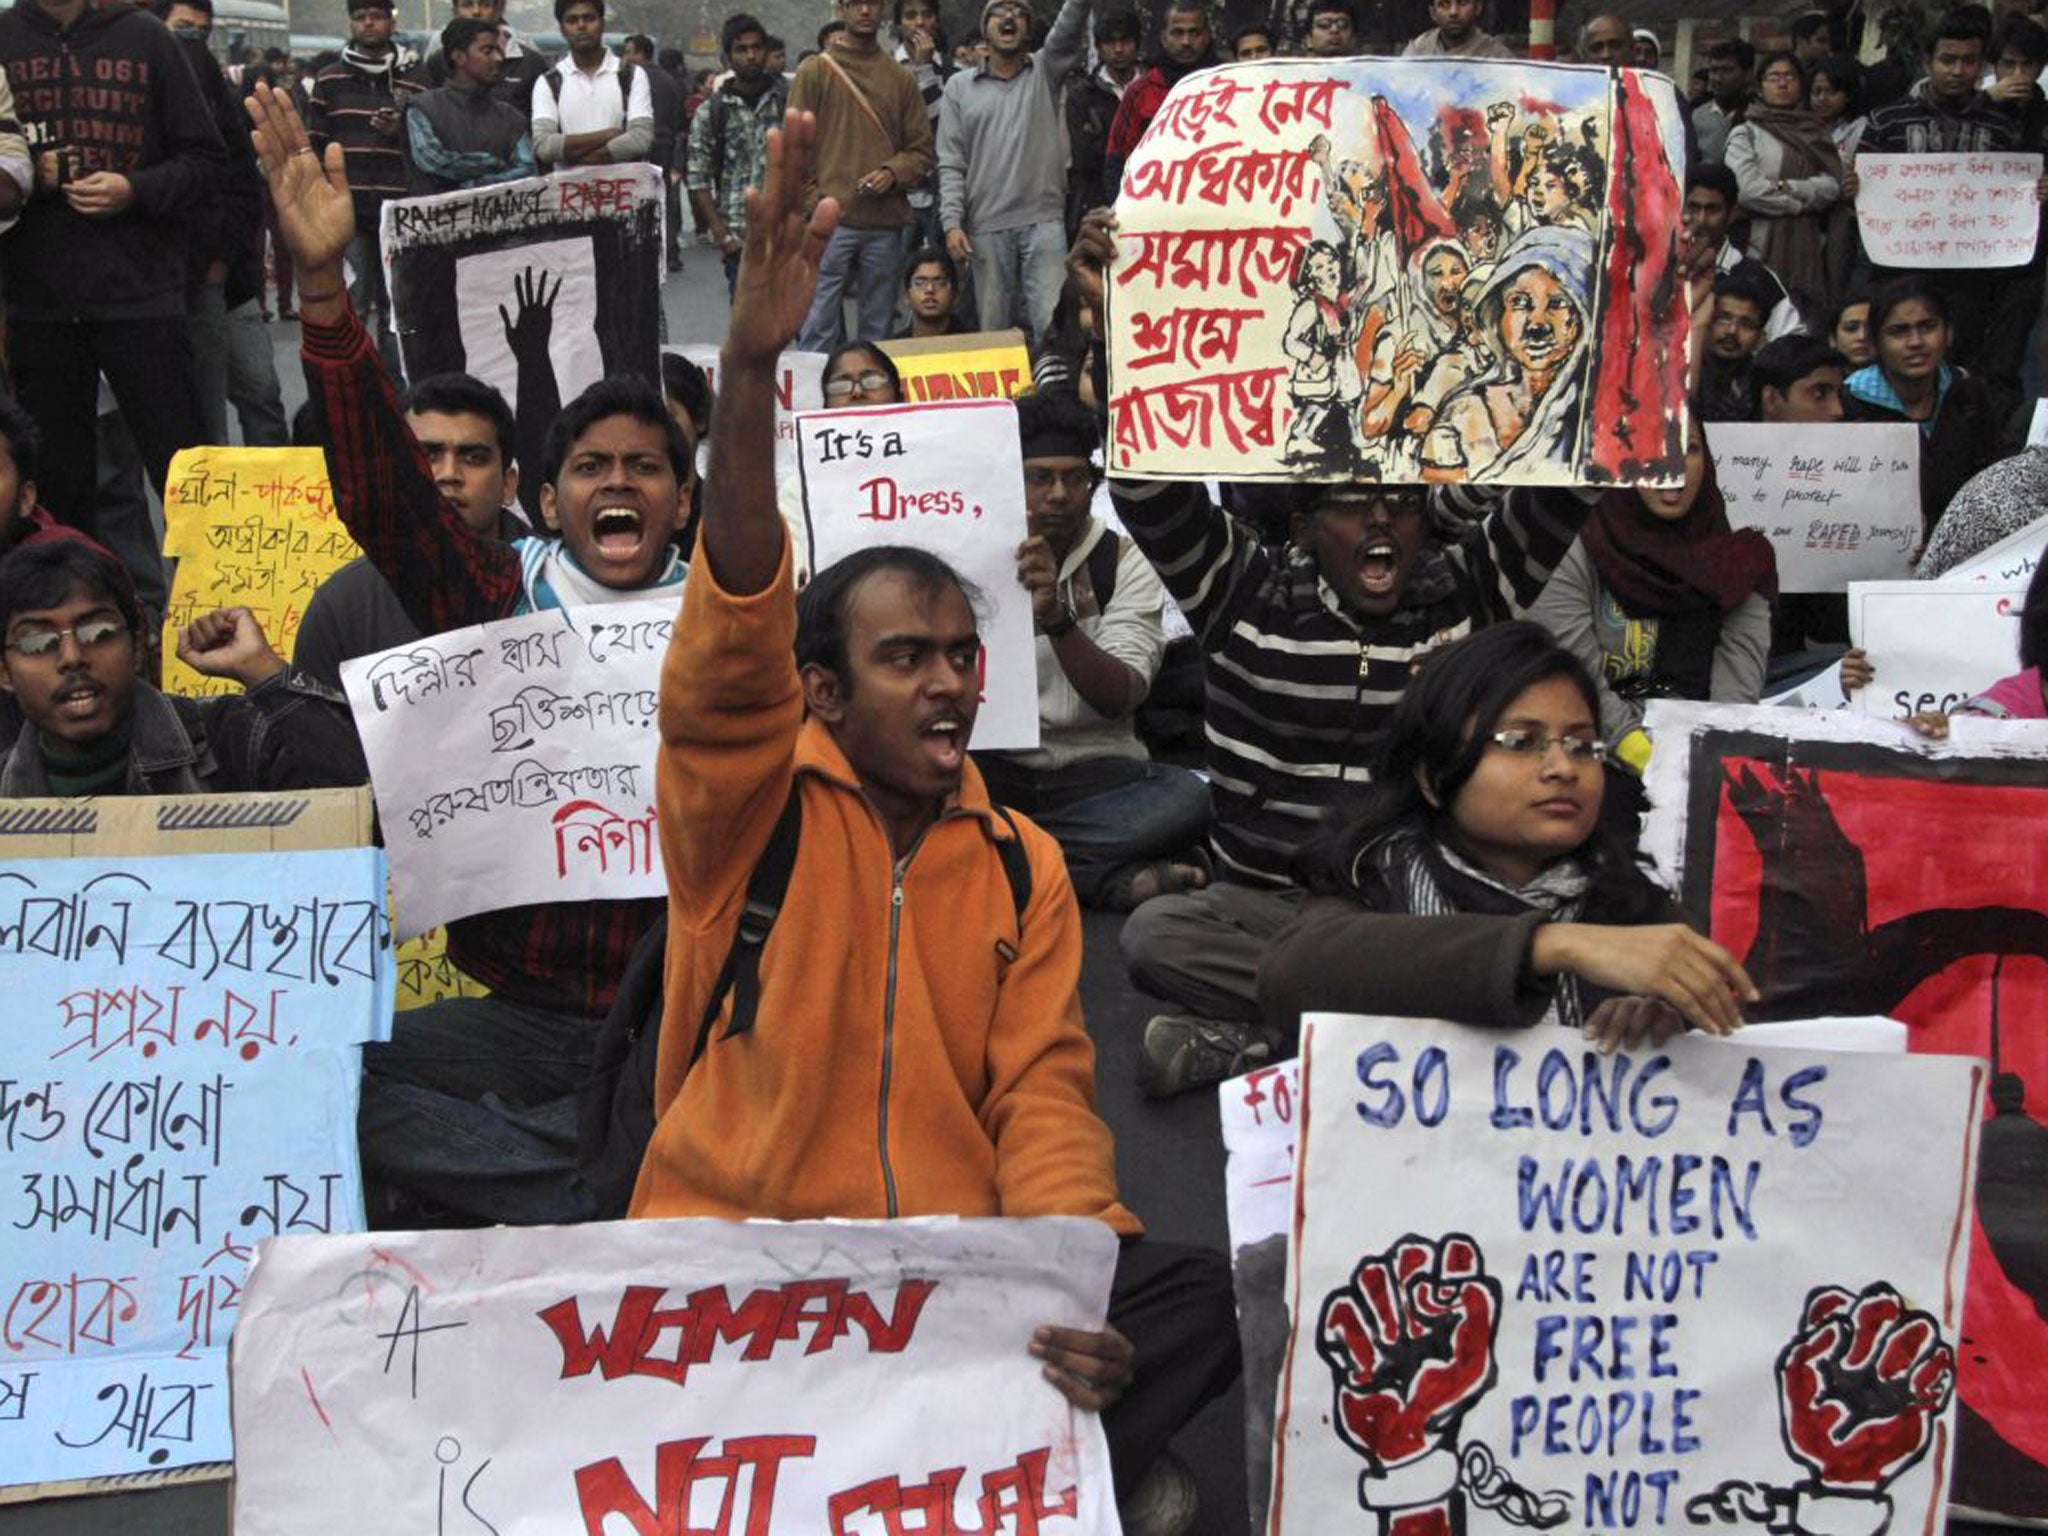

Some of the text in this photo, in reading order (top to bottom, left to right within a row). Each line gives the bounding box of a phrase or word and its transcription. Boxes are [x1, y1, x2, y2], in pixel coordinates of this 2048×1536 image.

[1259, 78, 1350, 135] নেব
[560, 178, 637, 219] RAPE
[1117, 226, 1312, 297] সমাজে
[1127, 307, 1265, 370] শ্রমে
[814, 428, 871, 464] It's
[883, 432, 906, 457] a
[1833, 456, 1861, 473] will
[858, 477, 983, 522] Dress,
[1752, 488, 1767, 502] to
[84, 1073, 234, 1167] কোনো
[1243, 1067, 1299, 1126] FO
[1356, 1041, 1828, 1148] SO LONG AS
[1517, 1153, 1763, 1242] WOMEN
[1516, 1249, 1719, 1304] ARE NOT
[3, 1272, 138, 1355] হোক
[377, 1278, 939, 1399] A WOMAN
[1533, 1314, 1679, 1383] FREE
[1511, 1388, 1702, 1459] PEOPLE
[574, 1435, 817, 1535] NOT
[1584, 1469, 1680, 1529] NOT
